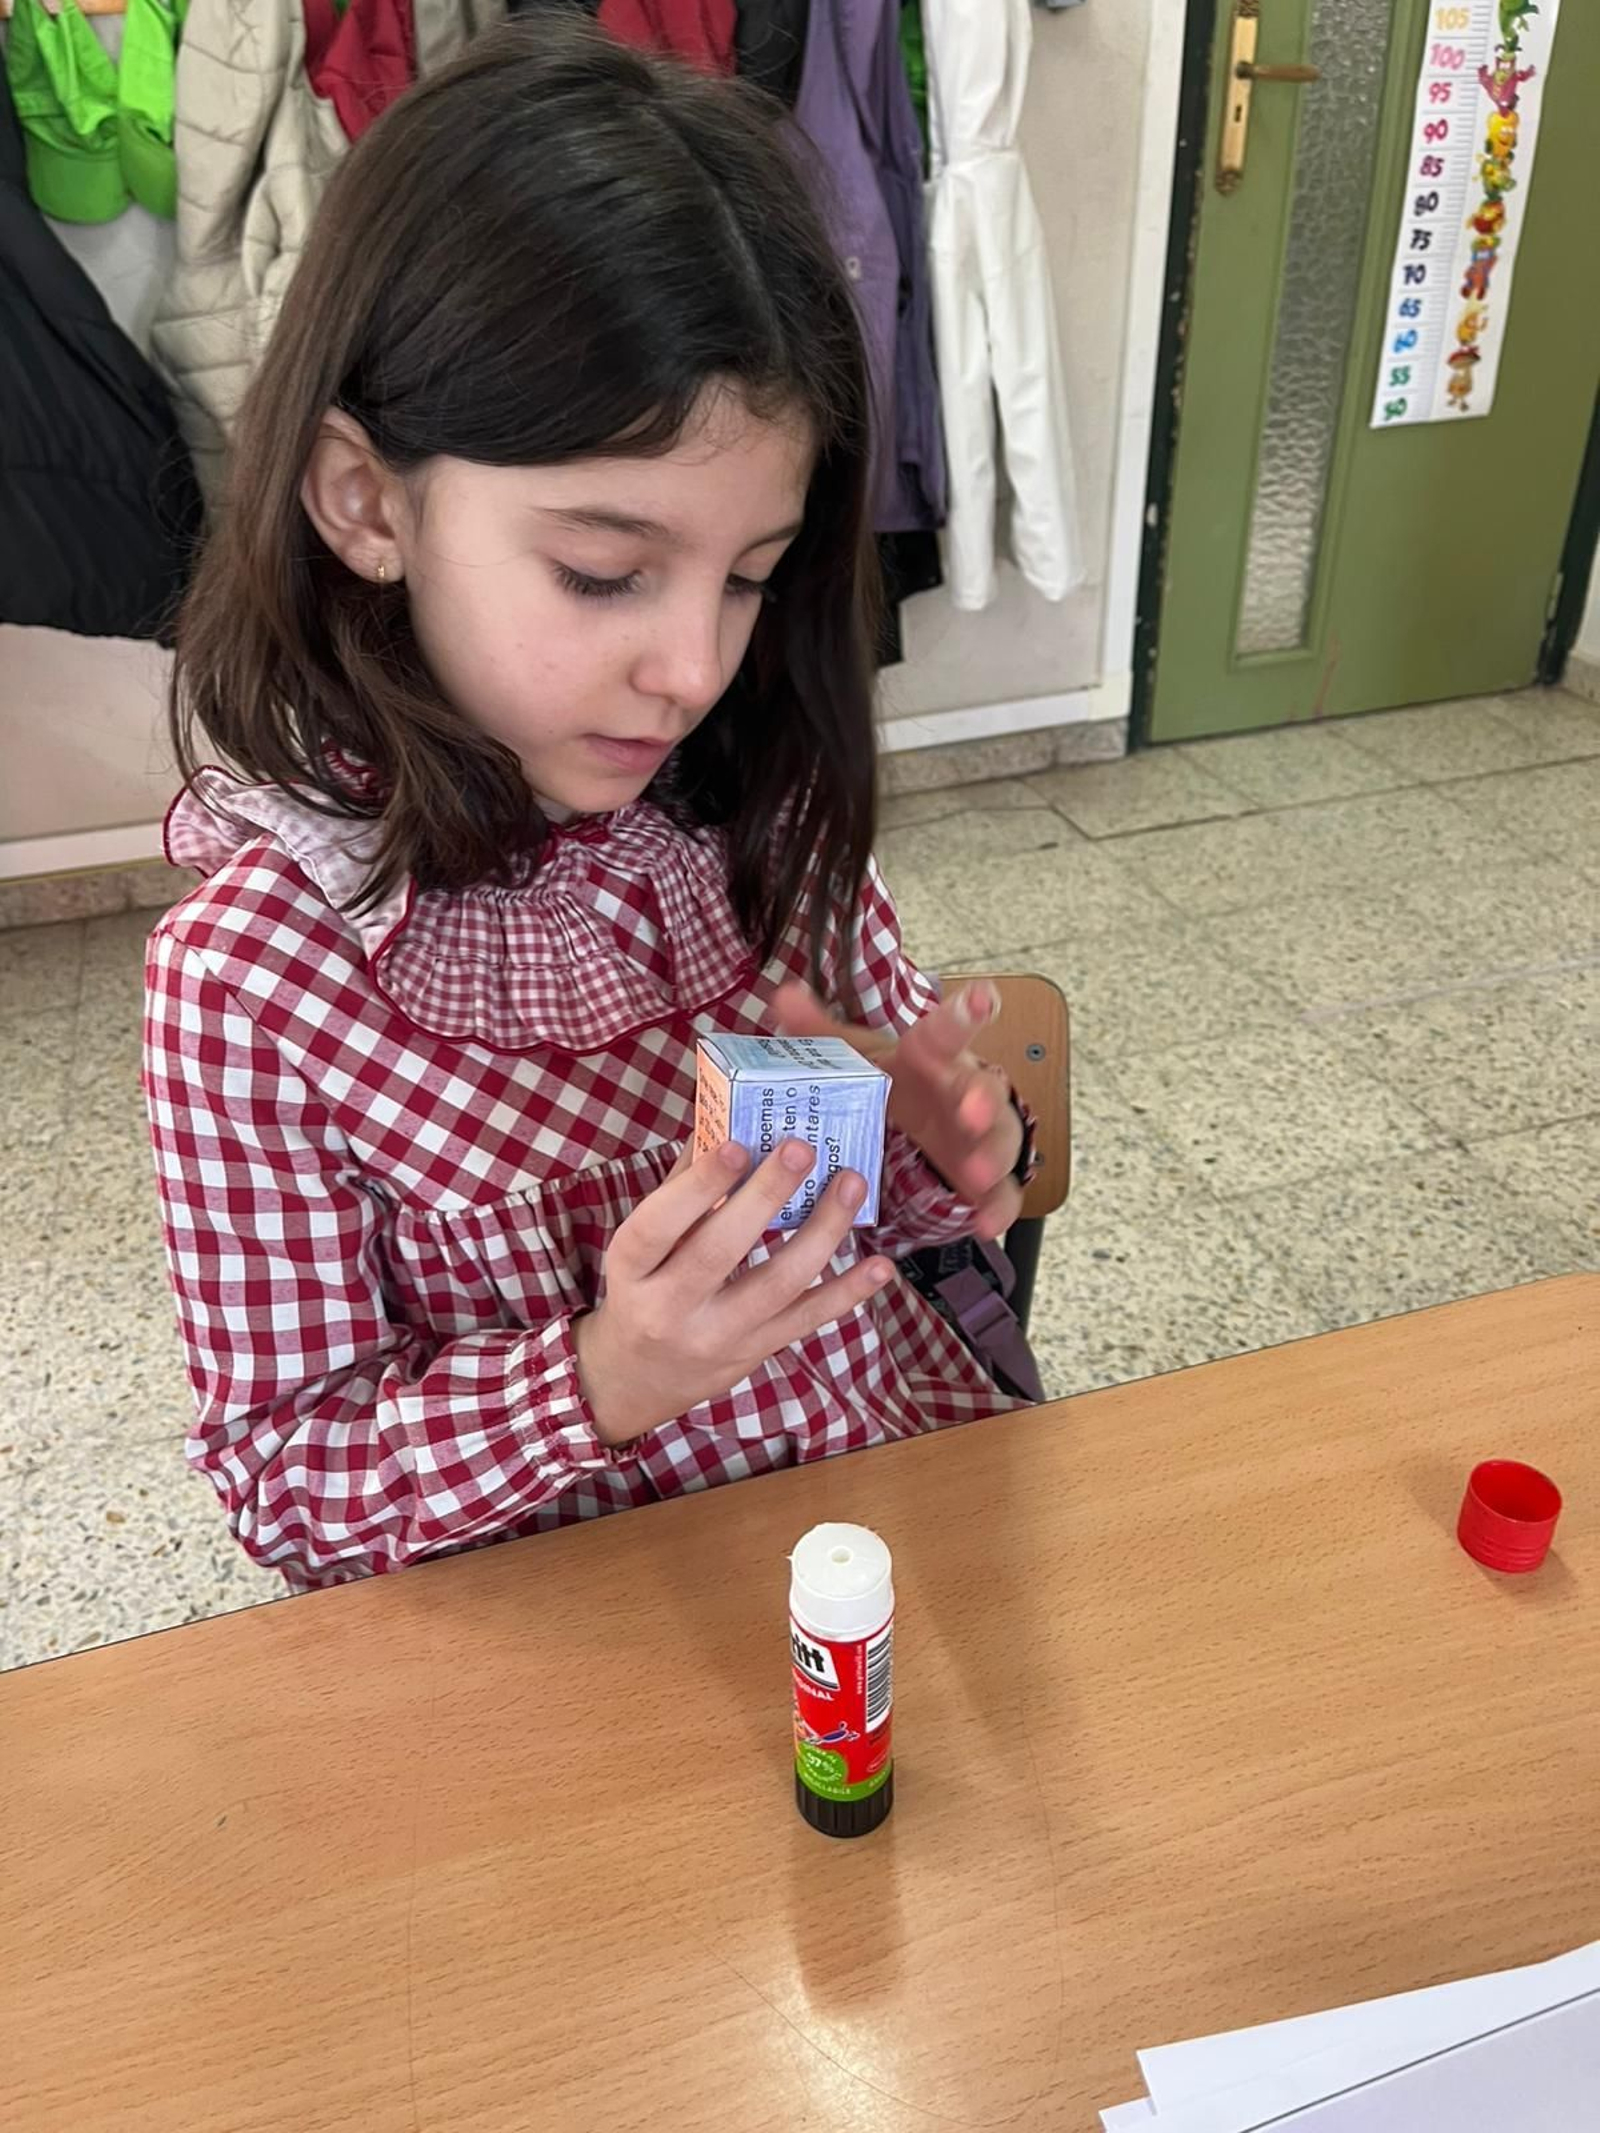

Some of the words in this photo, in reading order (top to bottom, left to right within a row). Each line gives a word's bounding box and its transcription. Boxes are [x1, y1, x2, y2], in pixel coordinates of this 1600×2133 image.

[1435, 7, 1470, 30] 105
[1429, 43, 1466, 70] 100
[1429, 82, 1453, 104] 95
[1424, 118, 1449, 144] 90
[1420, 155, 1445, 177] 85
[1414, 191, 1439, 217] 80
[1410, 229, 1432, 251] 75
[1403, 264, 1426, 285] 70
[1398, 298, 1421, 318] 65
[1393, 329, 1418, 353] 60
[1389, 365, 1411, 387] 55
[1384, 397, 1407, 421] 50
[786, 1087, 797, 1098] o
[761, 1087, 774, 1152] poemas
[782, 1105, 796, 1131] ten
[806, 1085, 820, 1149] ntares
[792, 1633, 825, 1673] ritt
